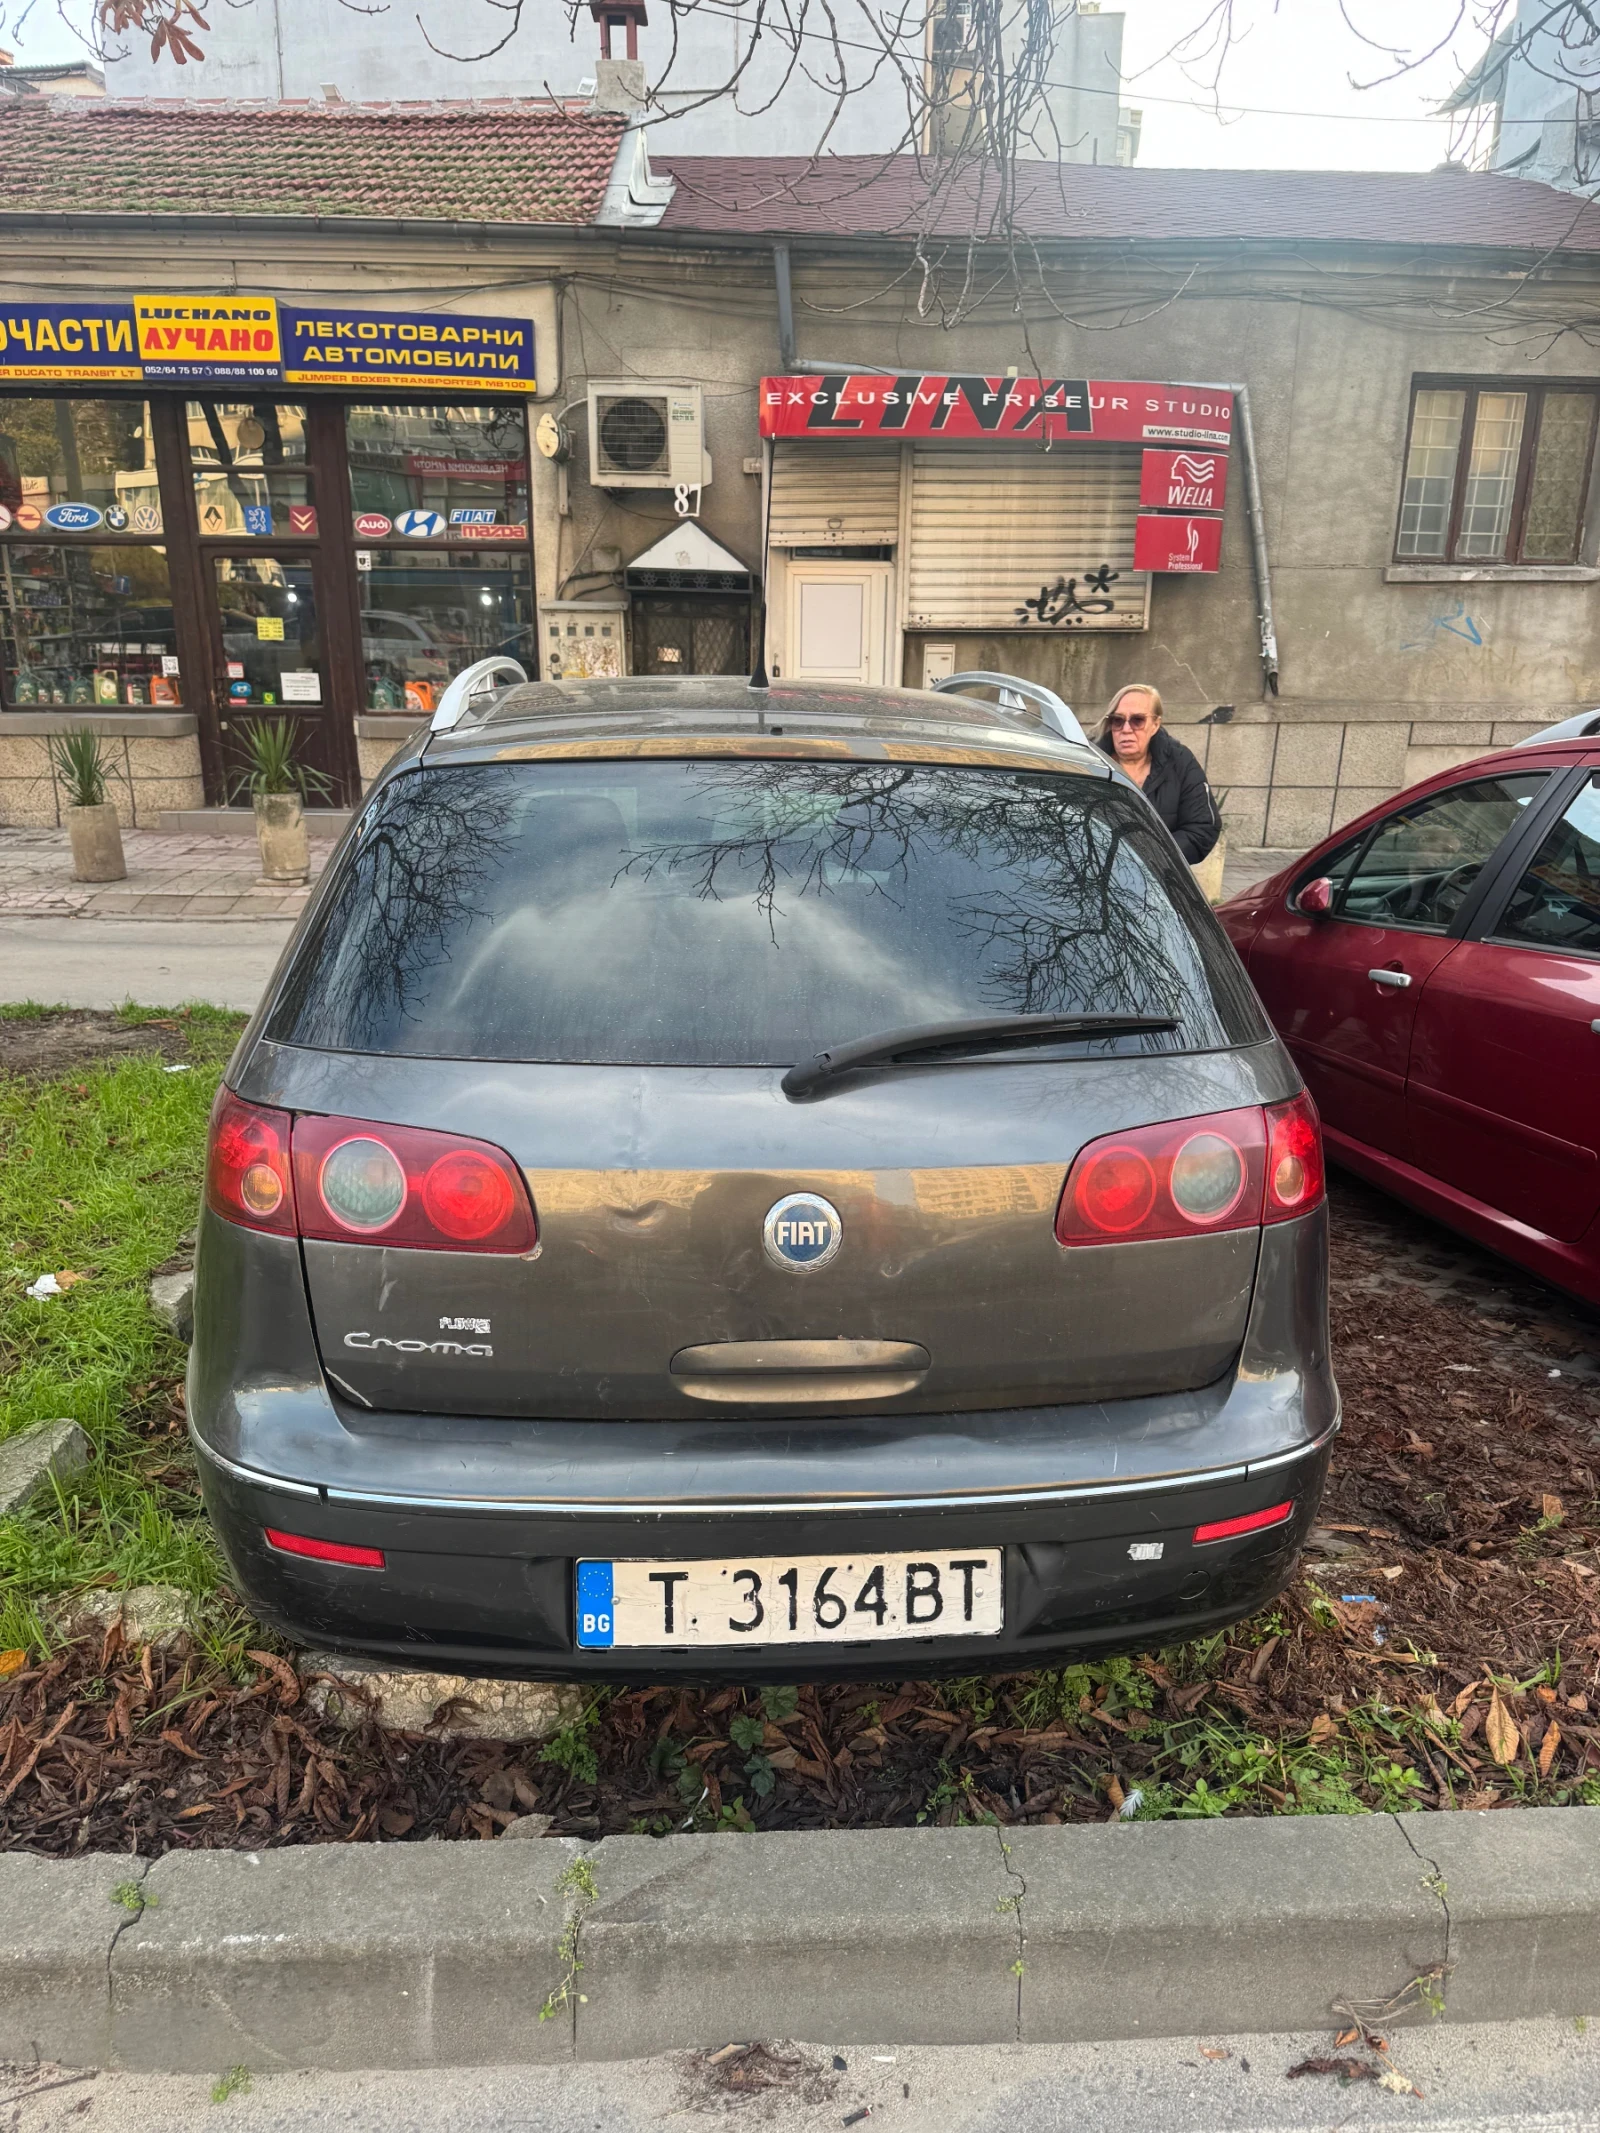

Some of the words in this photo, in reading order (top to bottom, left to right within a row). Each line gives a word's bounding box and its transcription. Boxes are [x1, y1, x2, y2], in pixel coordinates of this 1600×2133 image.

[140, 308, 271, 321] LUCHANO
[144, 327, 274, 352] ЛУЧАНО
[295, 320, 524, 346] ЛЕКОТОВАРНИ
[303, 346, 519, 369] АВТОМОБИЛИ
[66, 369, 117, 377] TRANSIT
[144, 366, 176, 374] 052/64
[178, 366, 190, 374] 75
[192, 367, 203, 375] 57
[248, 368, 264, 376] 100
[266, 368, 278, 376] 60
[298, 374, 347, 383] JUMPER
[352, 376, 392, 384] BOXER
[393, 377, 481, 387] TRANSPORTER
[486, 380, 526, 389] MB100
[766, 392, 960, 406] EXCLUSIVE
[982, 393, 1128, 411] FRISEUR
[1145, 398, 1231, 419] STUDIO
[807, 376, 1094, 433] LINA
[674, 483, 702, 517] 87
[1168, 486, 1214, 507] WELLA
[58, 508, 89, 523] Ford
[358, 519, 388, 529] Audi
[451, 510, 495, 523] FIAT
[1168, 553, 1190, 562] System
[1168, 562, 1203, 570] Professional
[777, 1221, 828, 1245] FIAT
[344, 1332, 493, 1357] Croma
[583, 1613, 610, 1633] BG
